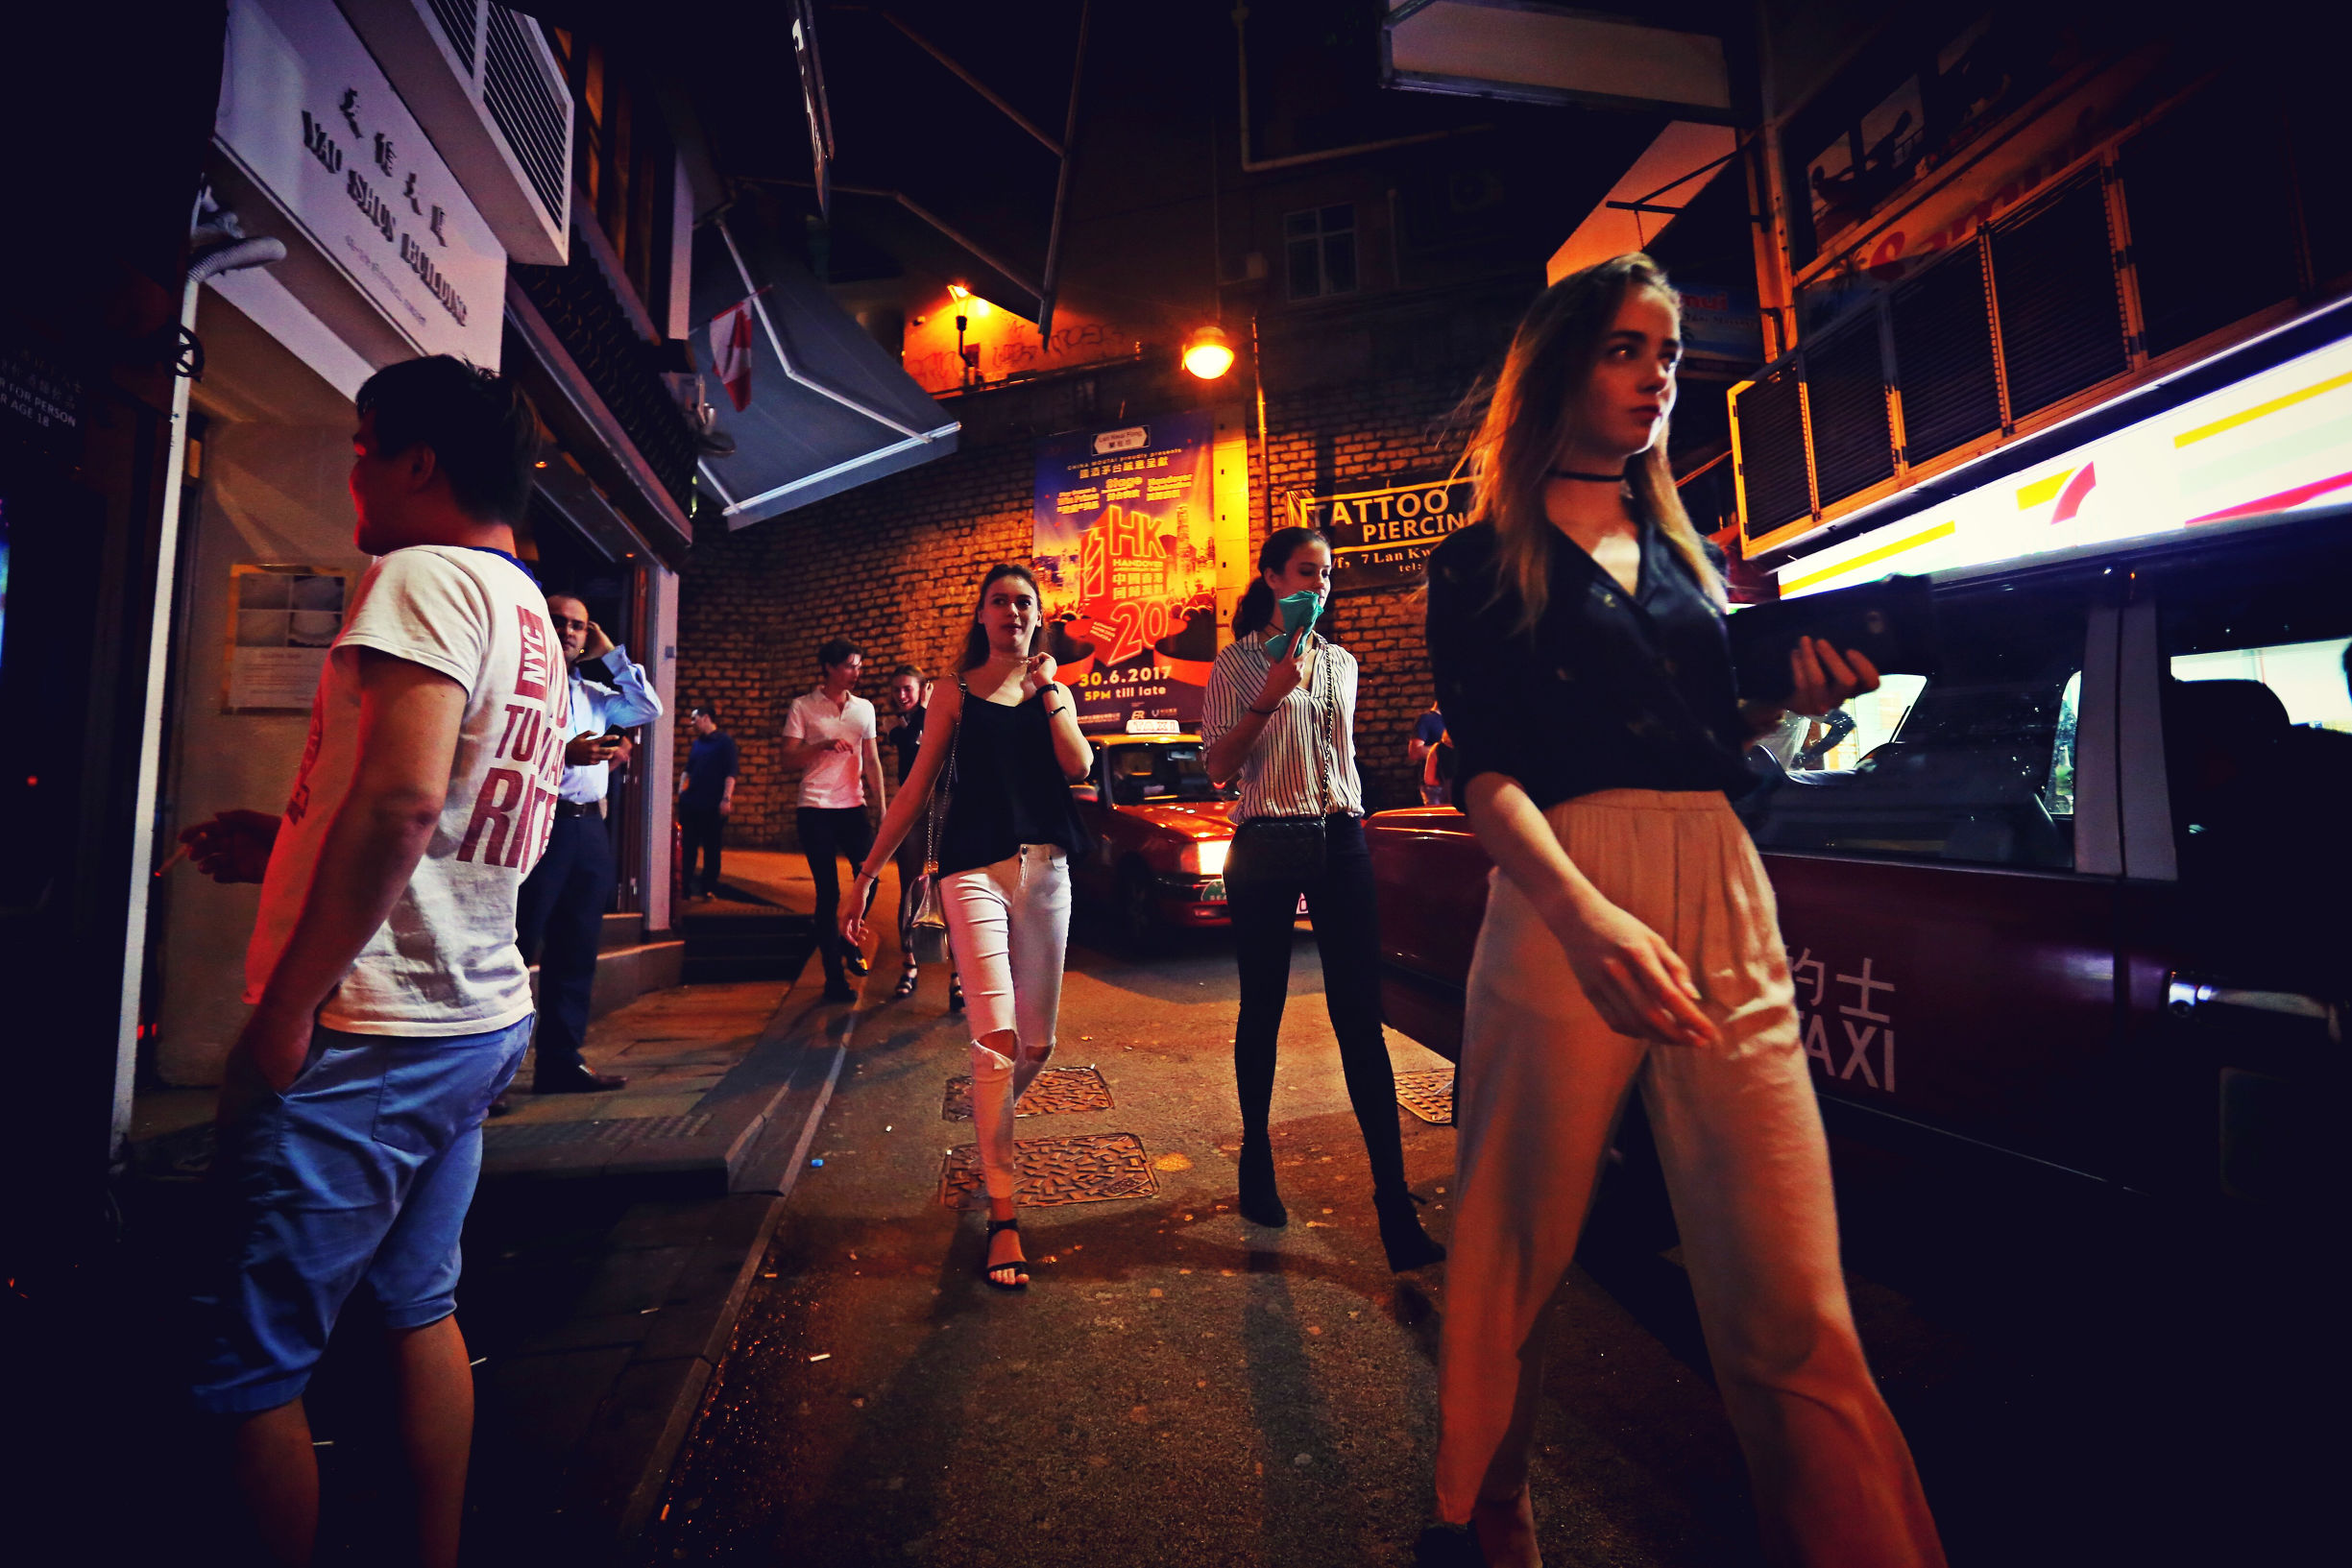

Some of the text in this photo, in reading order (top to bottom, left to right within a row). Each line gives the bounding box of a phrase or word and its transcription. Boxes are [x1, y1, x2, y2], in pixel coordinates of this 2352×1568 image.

[301, 109, 342, 174] YAU
[346, 169, 396, 242] SHUN
[400, 232, 468, 327] BUILDING
[10, 398, 34, 420] AGE
[37, 412, 50, 428] 18
[34, 396, 77, 428] PERSON
[1109, 503, 1168, 559] HK
[1362, 512, 1467, 543] PIERCIN
[1112, 559, 1164, 568] HANDOVER
[1361, 554, 1370, 565] 7
[1373, 550, 1404, 565] Lan
[1408, 546, 1433, 560] Kw
[1398, 563, 1422, 573] tel:
[1107, 600, 1170, 666] 20
[521, 624, 546, 688] NYC
[1078, 664, 1173, 688] 30.6.2017
[1084, 686, 1167, 702] 5PM till late
[1133, 721, 1176, 732] TAXI
